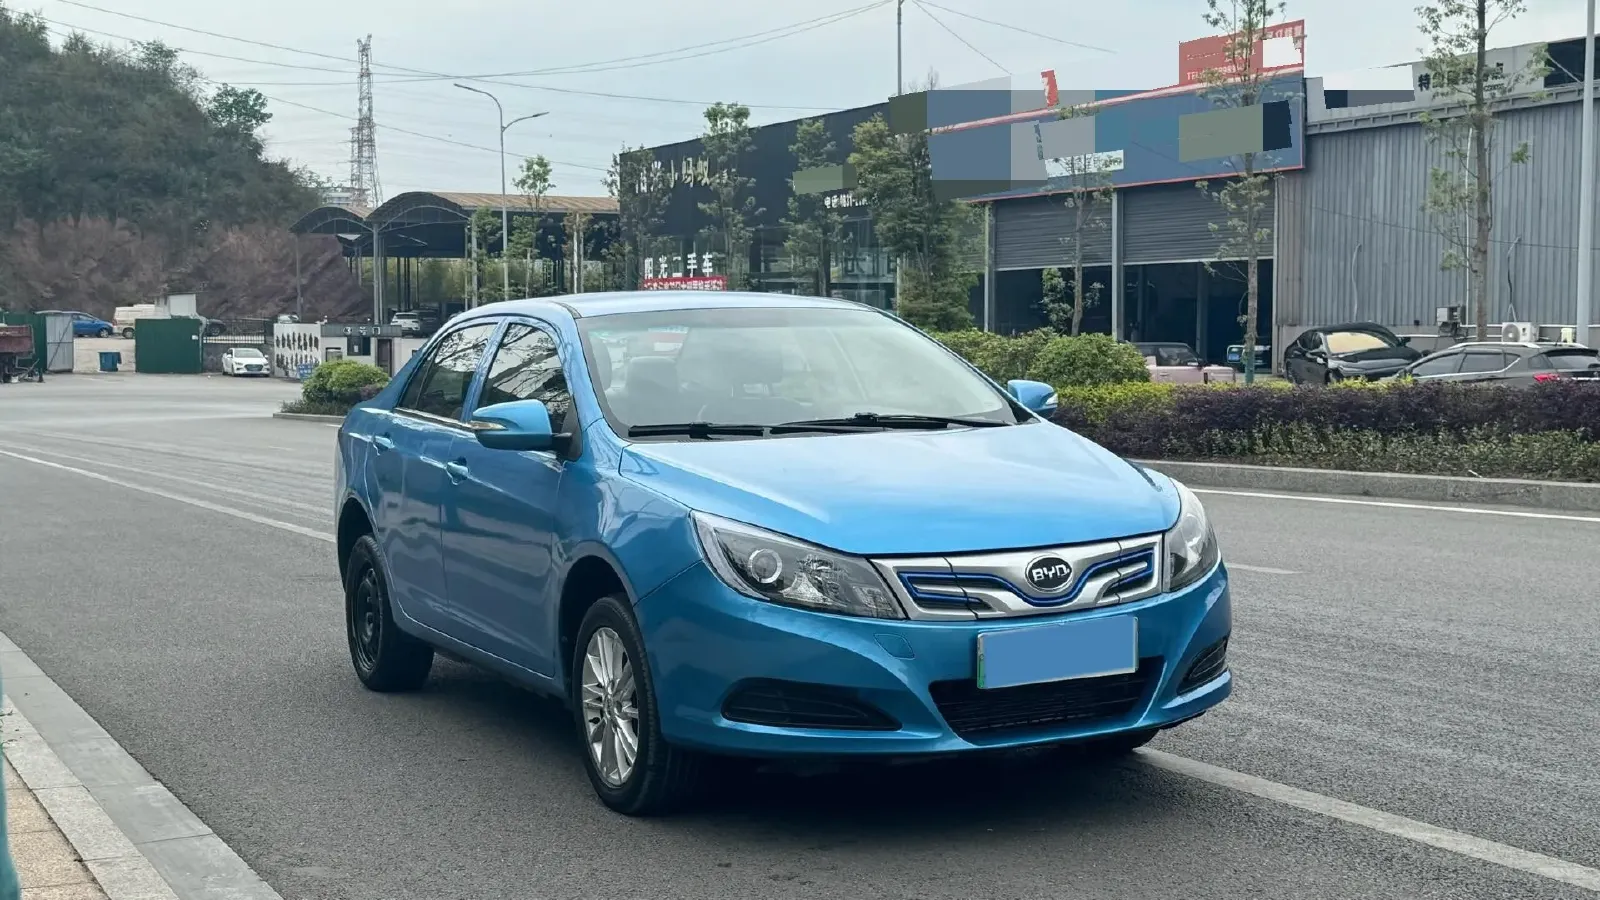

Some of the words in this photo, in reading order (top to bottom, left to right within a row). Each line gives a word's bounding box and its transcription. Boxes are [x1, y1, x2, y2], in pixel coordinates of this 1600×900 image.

[644, 251, 714, 279] 阳光二手车
[1031, 564, 1070, 582] BYD
